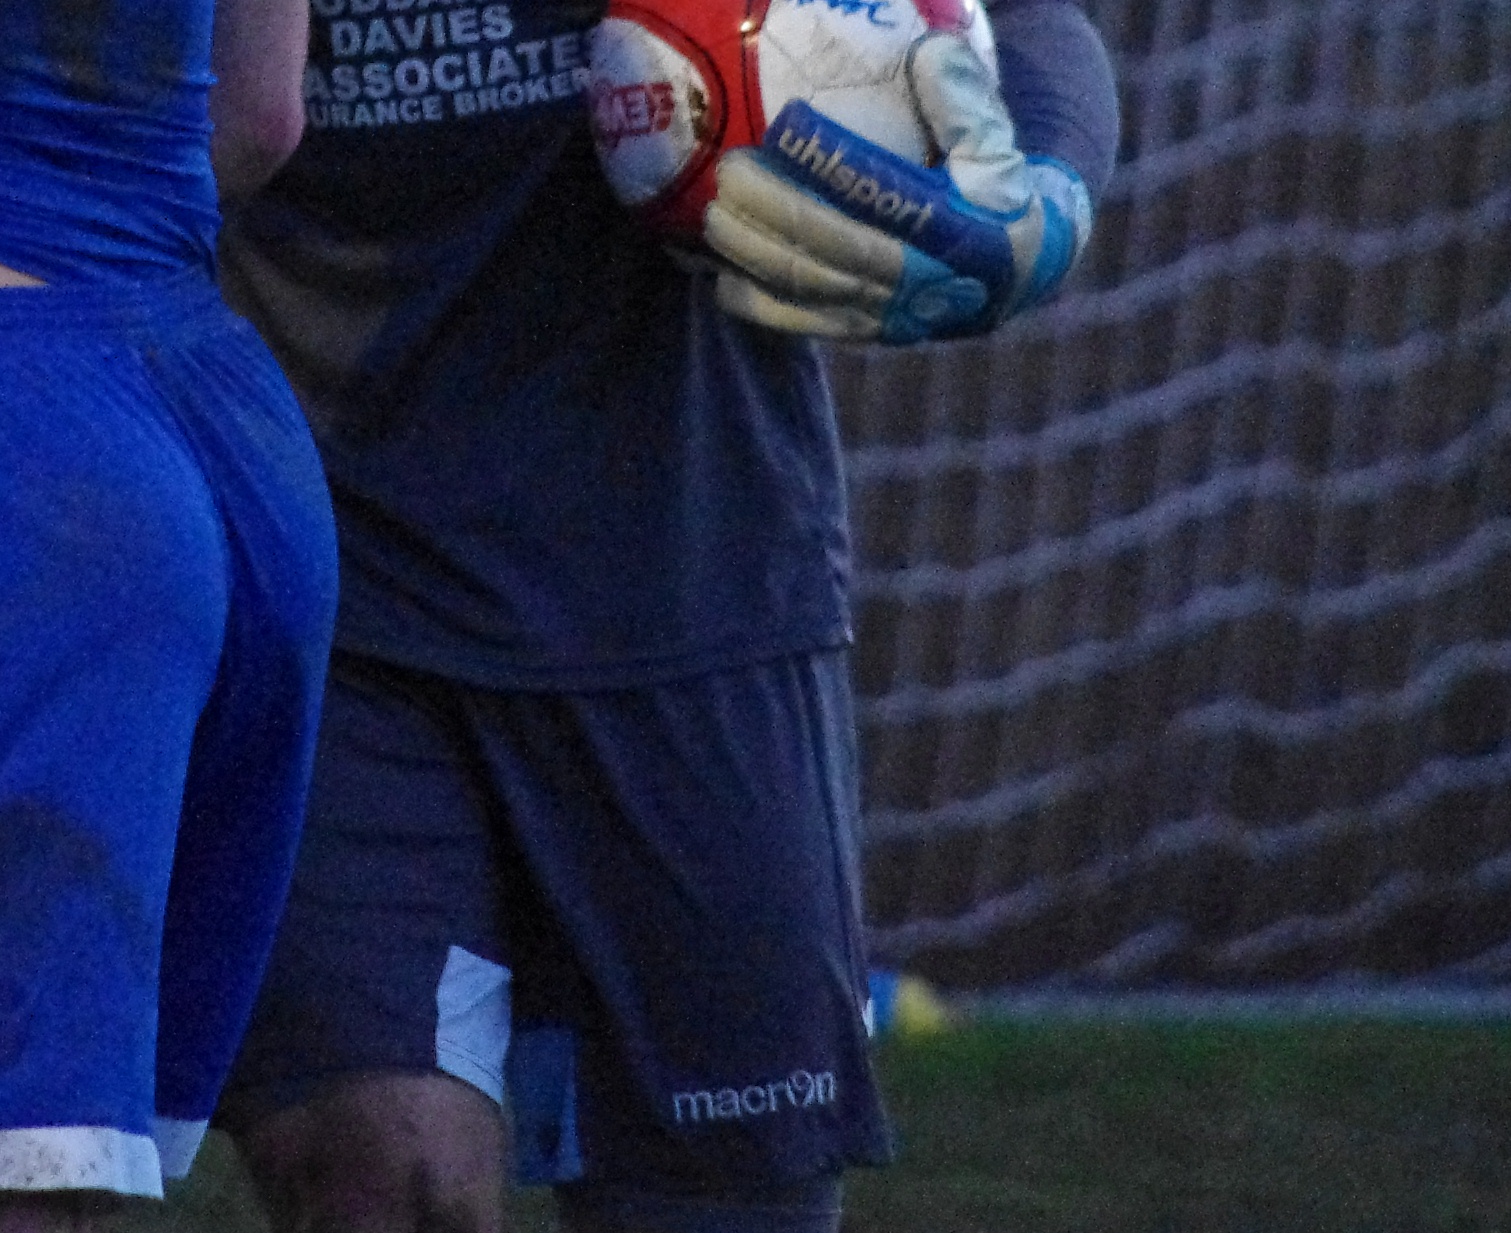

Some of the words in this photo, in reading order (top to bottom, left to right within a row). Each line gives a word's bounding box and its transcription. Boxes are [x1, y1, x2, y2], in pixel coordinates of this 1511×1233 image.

[331, 4, 513, 57] DAVIES
[304, 32, 584, 101] ASSOCIATE
[308, 95, 444, 129] URANCE
[453, 67, 591, 117] BROKER
[779, 125, 935, 228] uhlsport
[672, 1070, 836, 1122] macron
